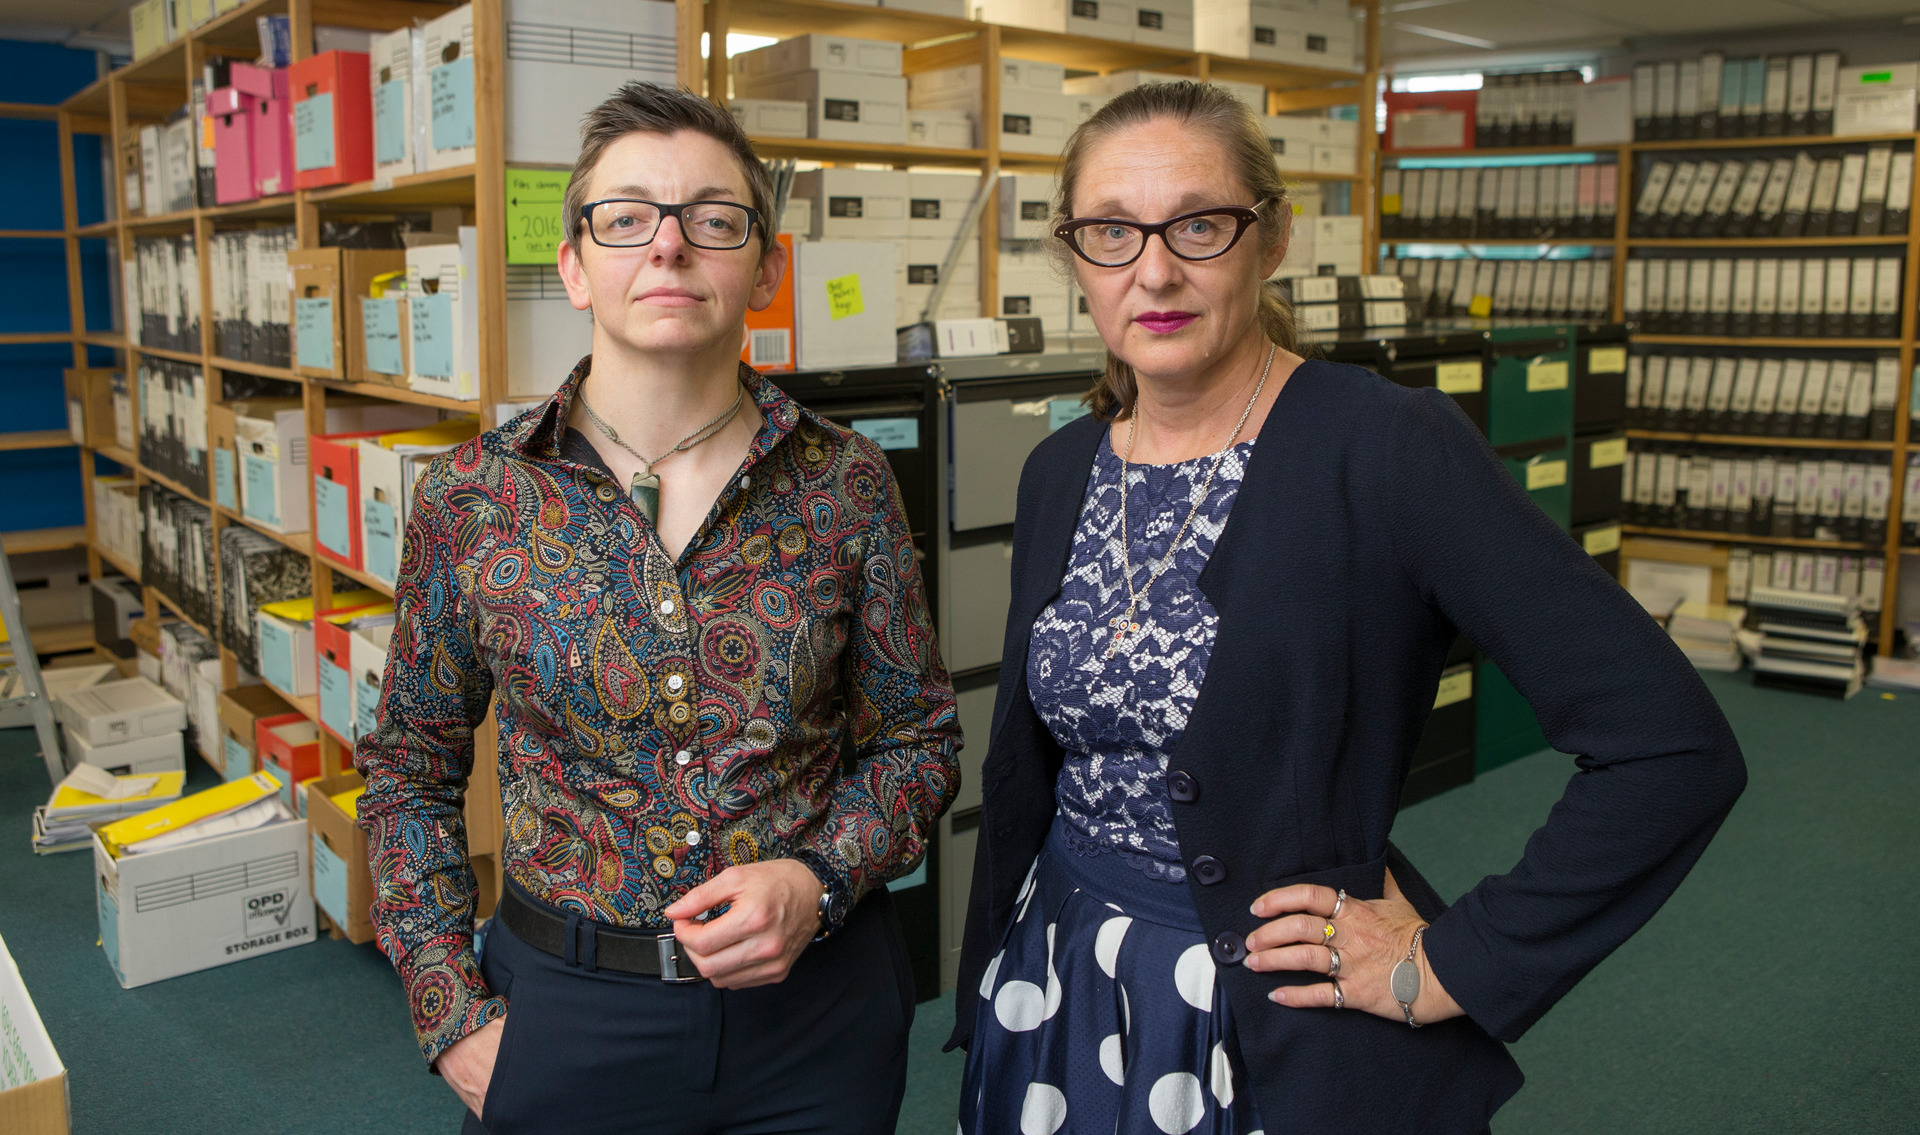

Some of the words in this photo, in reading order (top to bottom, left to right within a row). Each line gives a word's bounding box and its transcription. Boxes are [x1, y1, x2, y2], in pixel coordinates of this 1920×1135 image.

[520, 214, 560, 239] 2016
[248, 893, 284, 910] OPD
[225, 934, 282, 955] STORAGE
[285, 926, 309, 940] BOX
